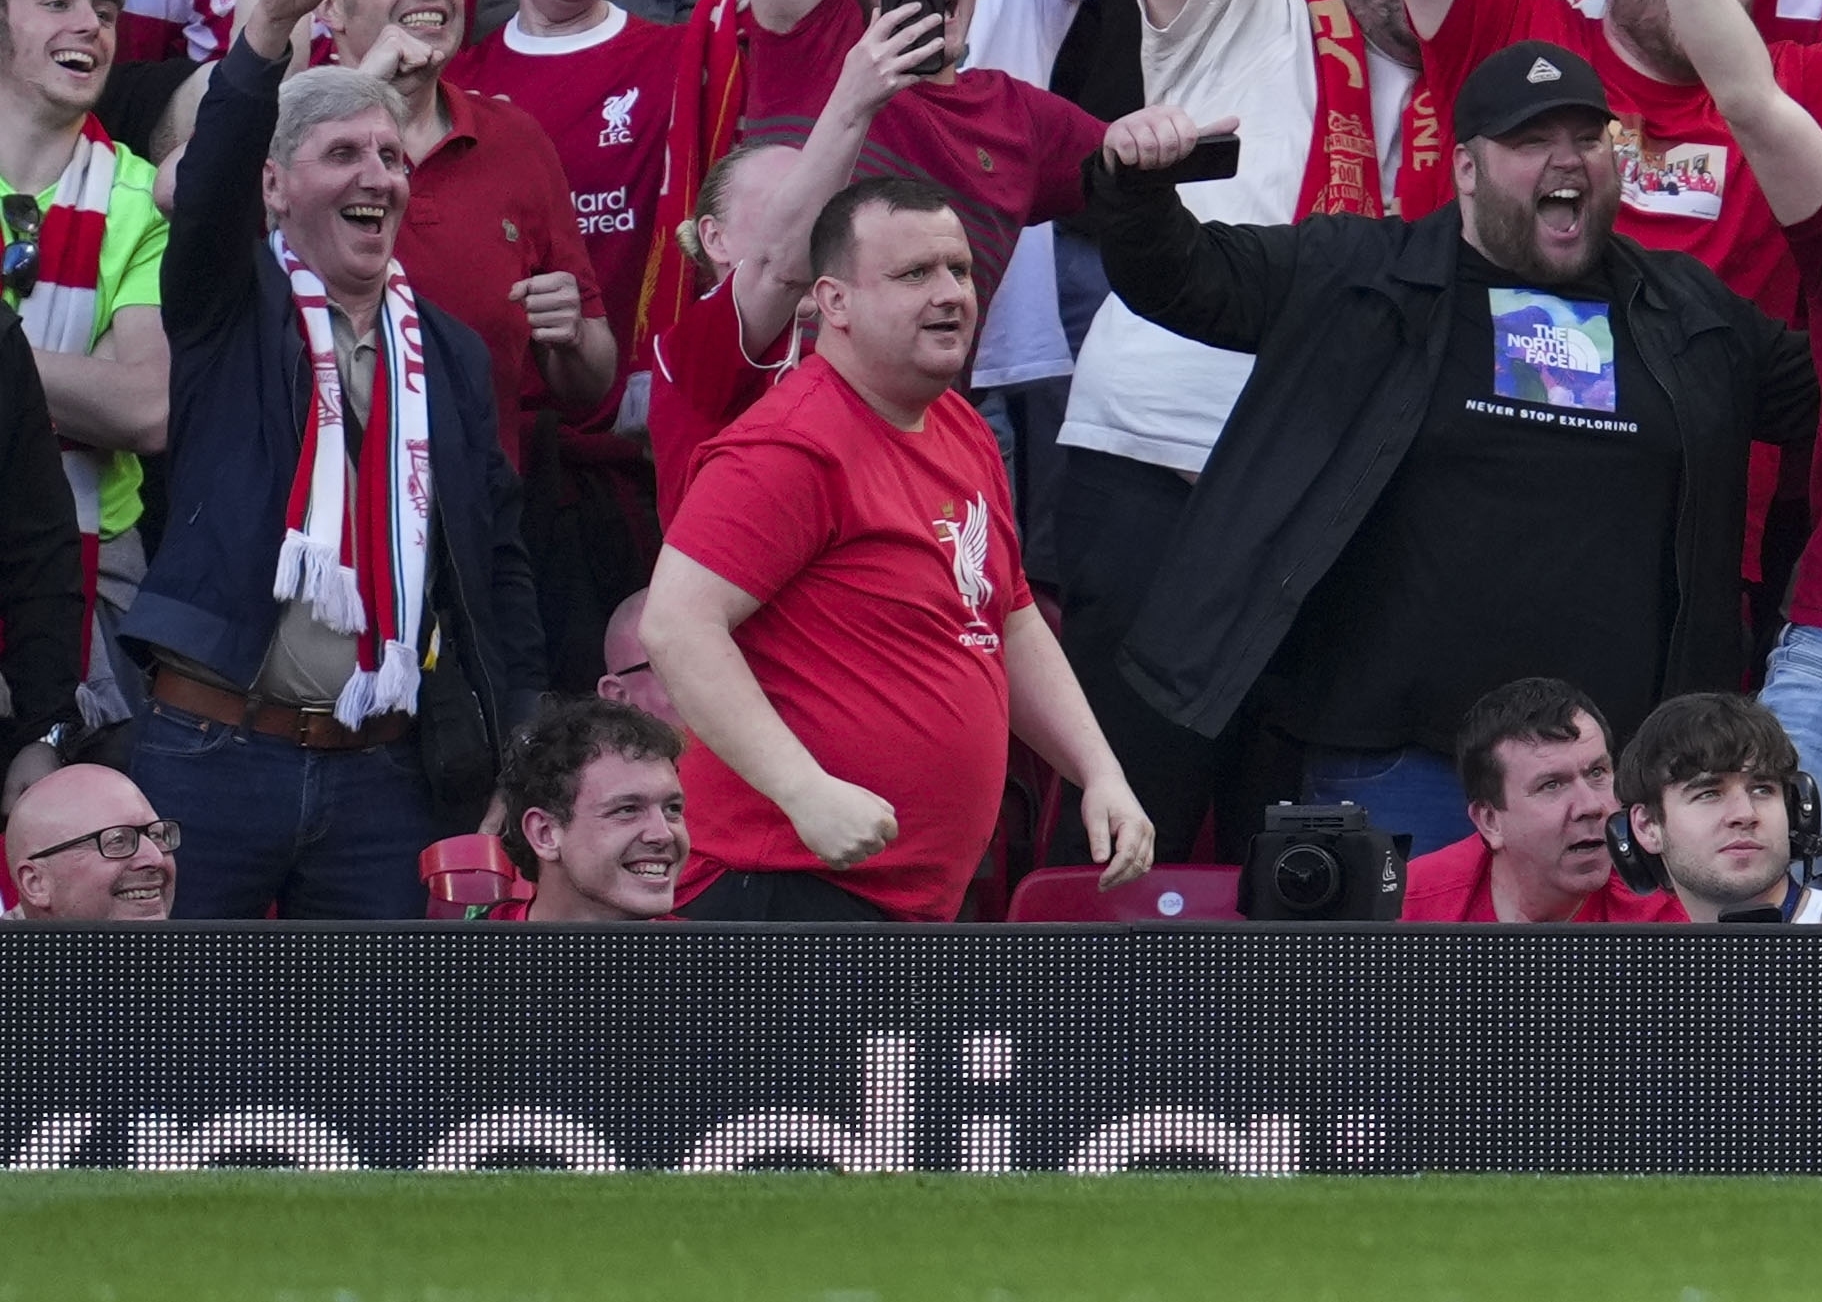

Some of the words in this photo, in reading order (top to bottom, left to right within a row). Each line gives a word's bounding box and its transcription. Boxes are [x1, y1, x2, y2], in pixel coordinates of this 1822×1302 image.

[1532, 322, 1567, 342] THE
[1506, 337, 1567, 358] NORTH
[1524, 350, 1568, 371] FACE
[1465, 400, 1515, 418] NEVER
[1520, 404, 1555, 424] STOP
[1559, 409, 1638, 434] EXPLORING
